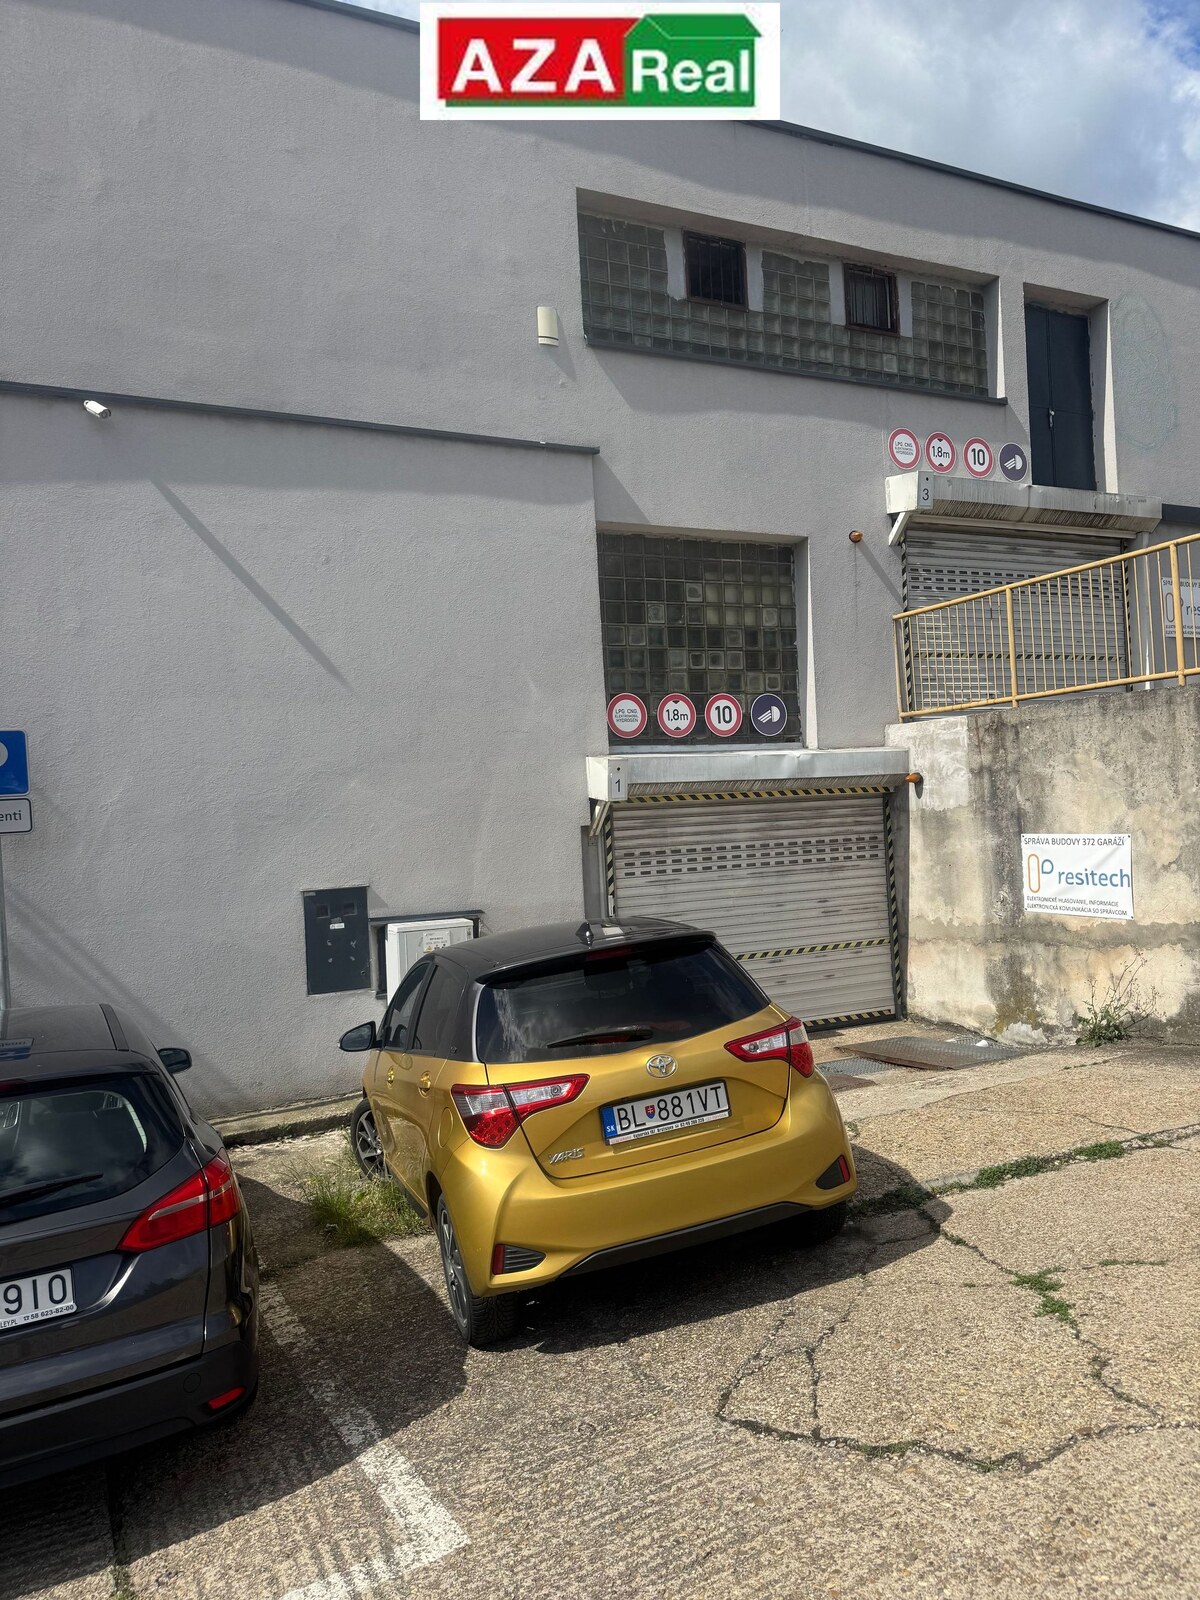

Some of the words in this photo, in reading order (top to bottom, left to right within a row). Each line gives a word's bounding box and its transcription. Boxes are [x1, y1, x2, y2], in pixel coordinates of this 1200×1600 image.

[971, 448, 986, 466] 10
[922, 488, 929, 500] 3
[715, 706, 732, 724] 10
[615, 778, 621, 792] 1
[1024, 836, 1050, 845] SPRÁVA
[1058, 868, 1130, 888] resitech
[617, 1105, 647, 1131] BL
[657, 1086, 722, 1121] 881VT
[548, 1147, 584, 1164] YARIS
[40, 1305, 74, 1317] 623-82-00
